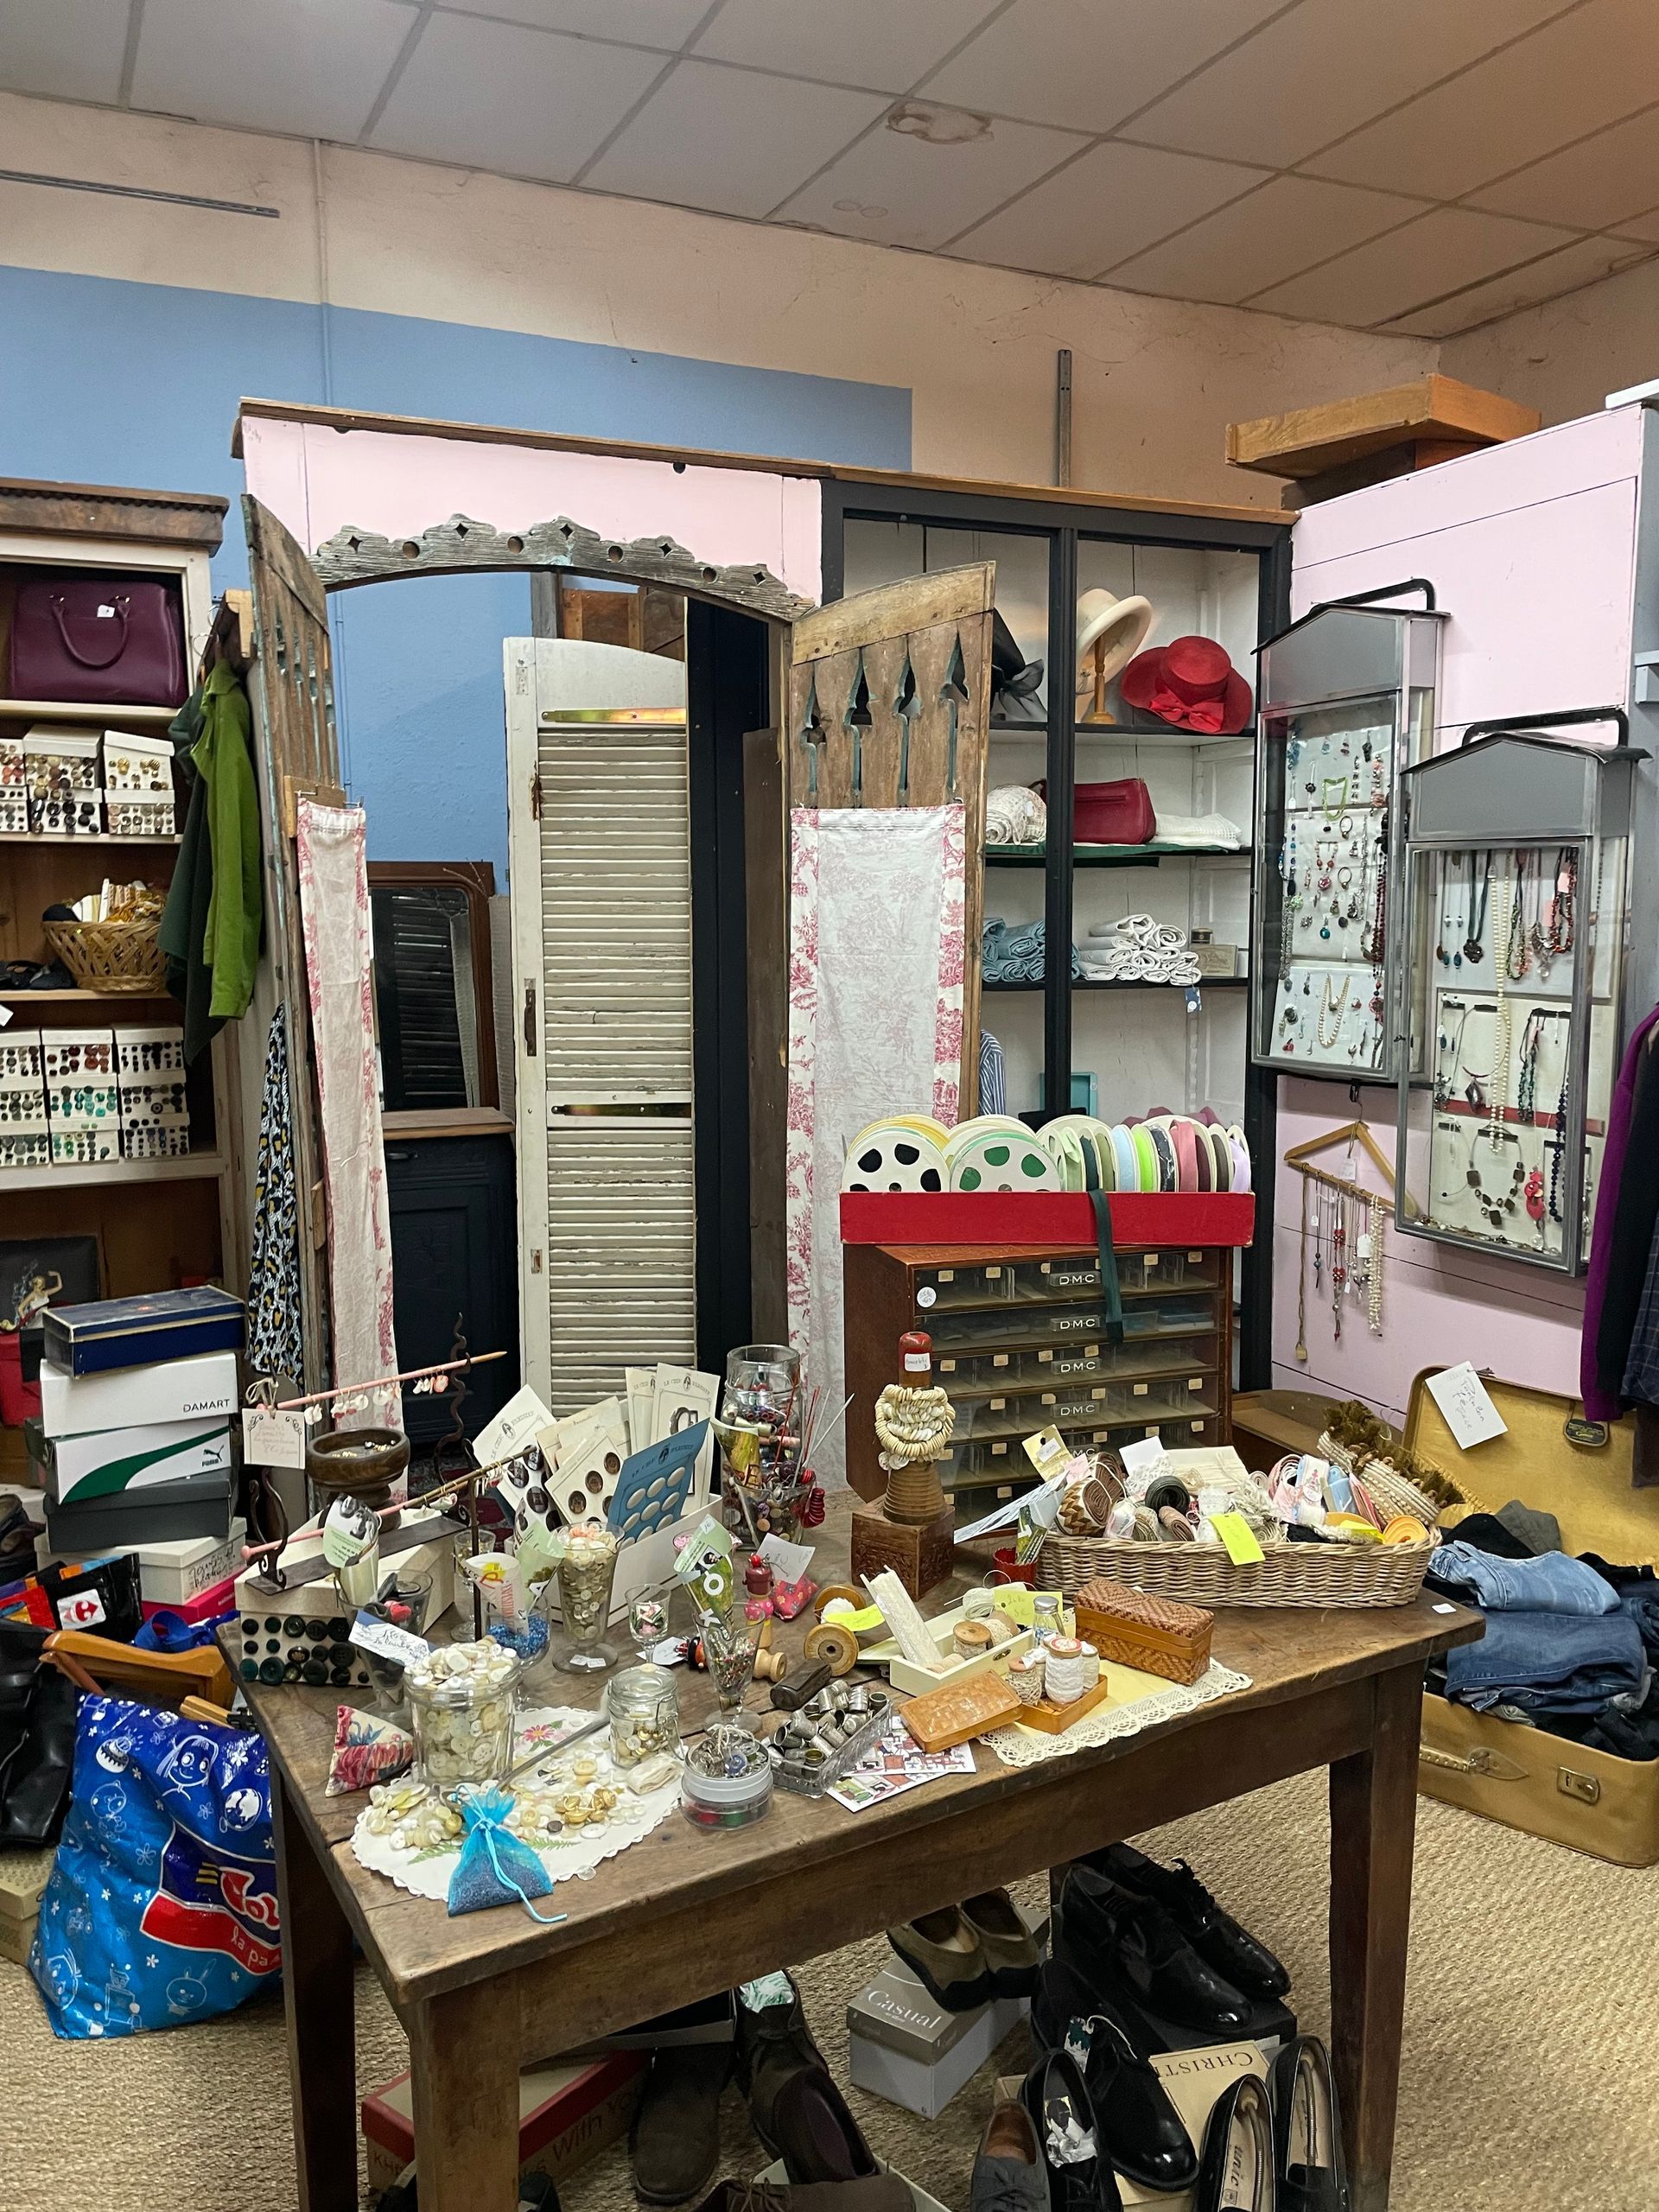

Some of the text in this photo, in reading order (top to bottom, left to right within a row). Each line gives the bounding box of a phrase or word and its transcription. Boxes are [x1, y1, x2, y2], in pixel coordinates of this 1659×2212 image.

[183, 1399, 230, 1413] DAMART
[868, 1990, 942, 2029] Casual
[1230, 2145, 1243, 2187] unic
